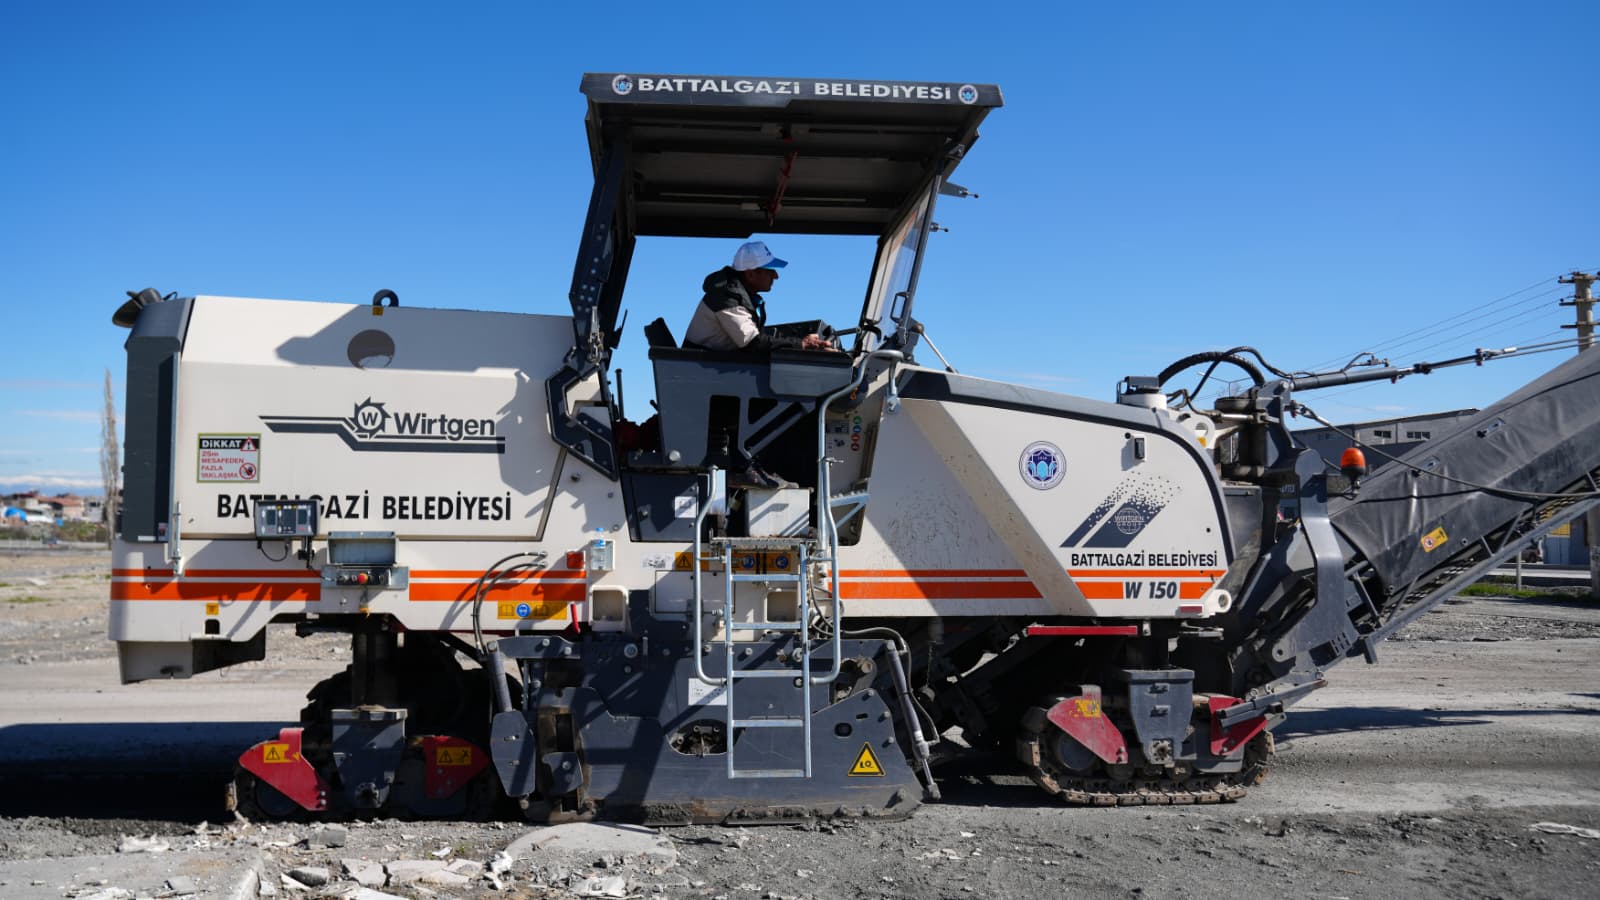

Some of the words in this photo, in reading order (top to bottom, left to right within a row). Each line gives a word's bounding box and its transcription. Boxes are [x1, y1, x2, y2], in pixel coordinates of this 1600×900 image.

[394, 412, 495, 441] Wirtgen
[382, 490, 511, 521] BELEDİYESİ
[1071, 550, 1144, 566] BATTALGAZİ
[1149, 550, 1217, 566] BELEDİYESİ
[1125, 582, 1142, 599] W
[1149, 582, 1178, 599] 150
